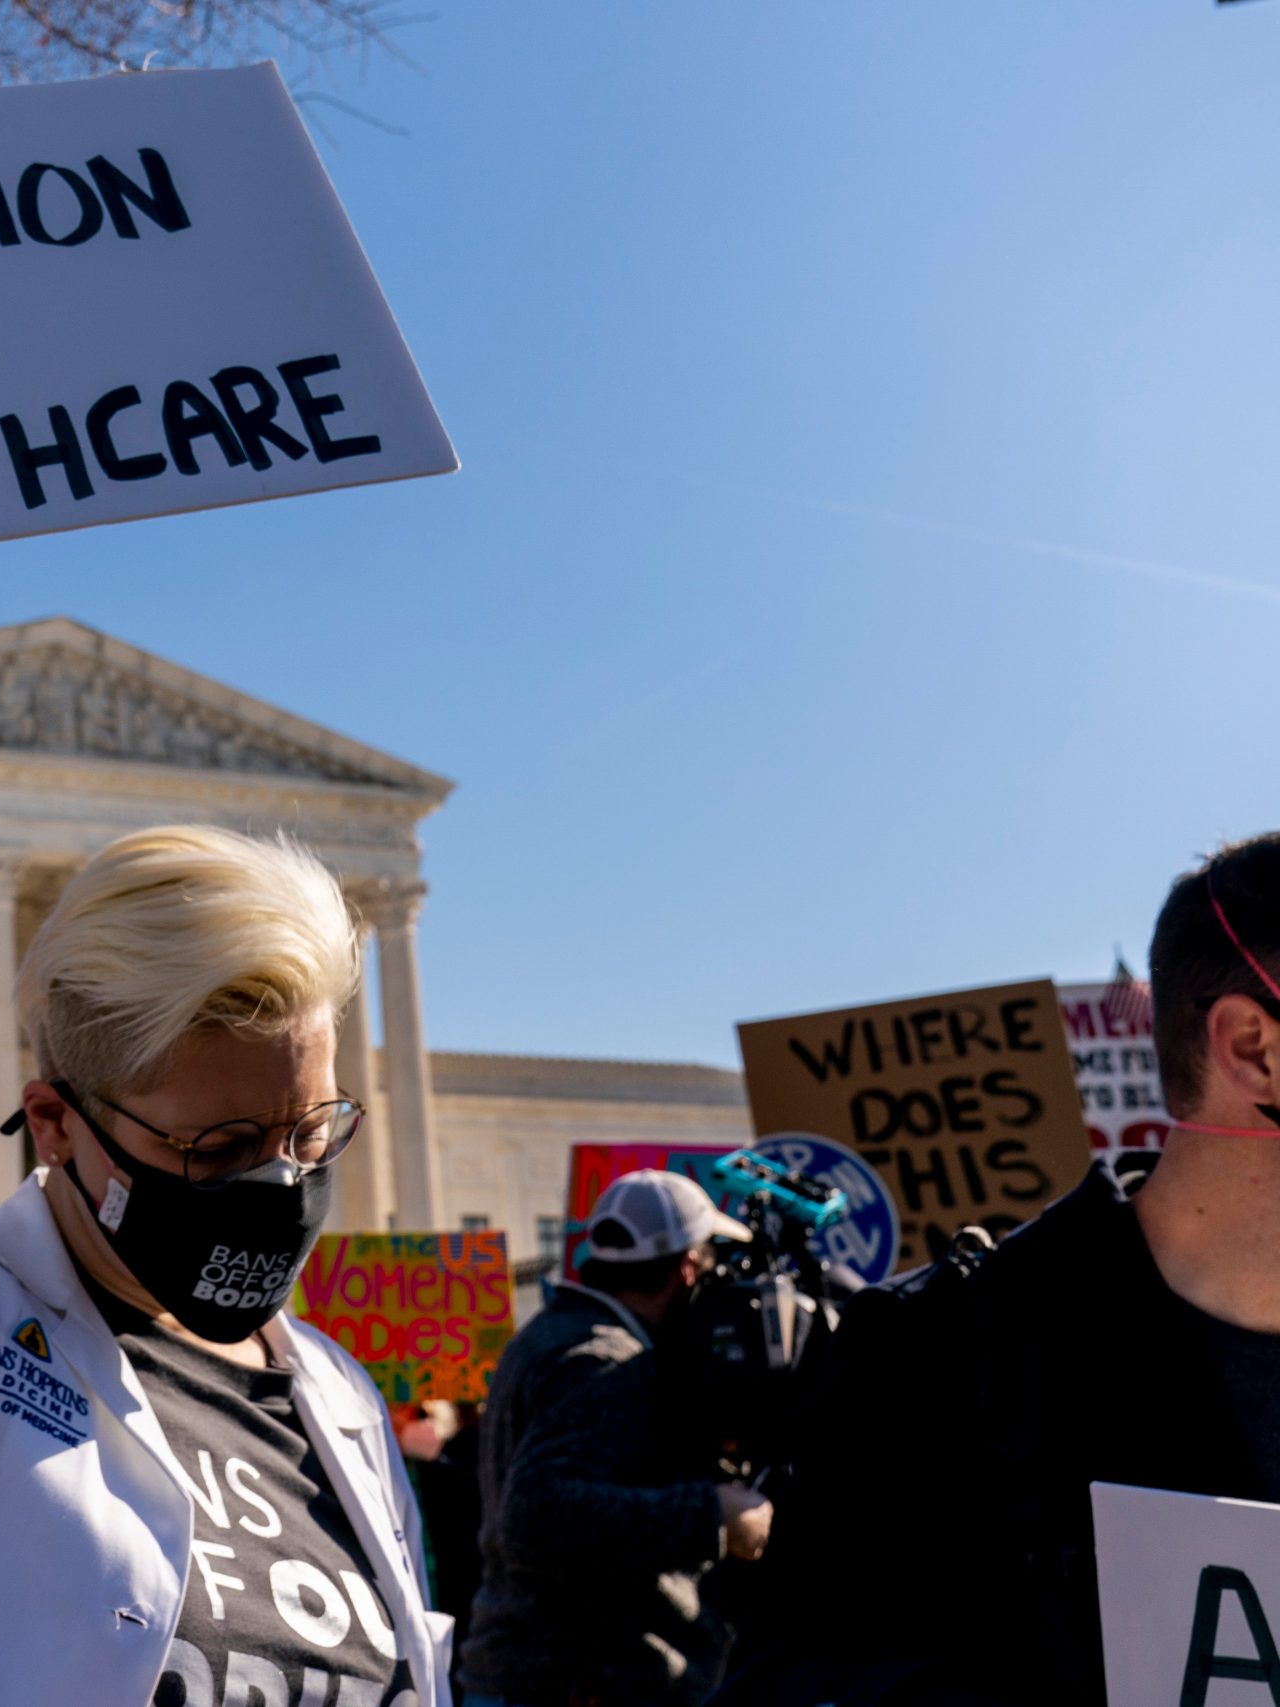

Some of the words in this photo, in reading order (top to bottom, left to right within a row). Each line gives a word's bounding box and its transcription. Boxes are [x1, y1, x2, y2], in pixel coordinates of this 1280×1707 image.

[787, 996, 1044, 1084] WHERE
[850, 1070, 1044, 1144] DOES
[209, 1245, 292, 1272] BANS
[438, 1228, 505, 1272] US
[200, 1263, 263, 1290] OFF
[17, 1357, 89, 1417] HOPKINS
[0, 1400, 22, 1417] OF
[21, 1408, 80, 1448] MEDICINE
